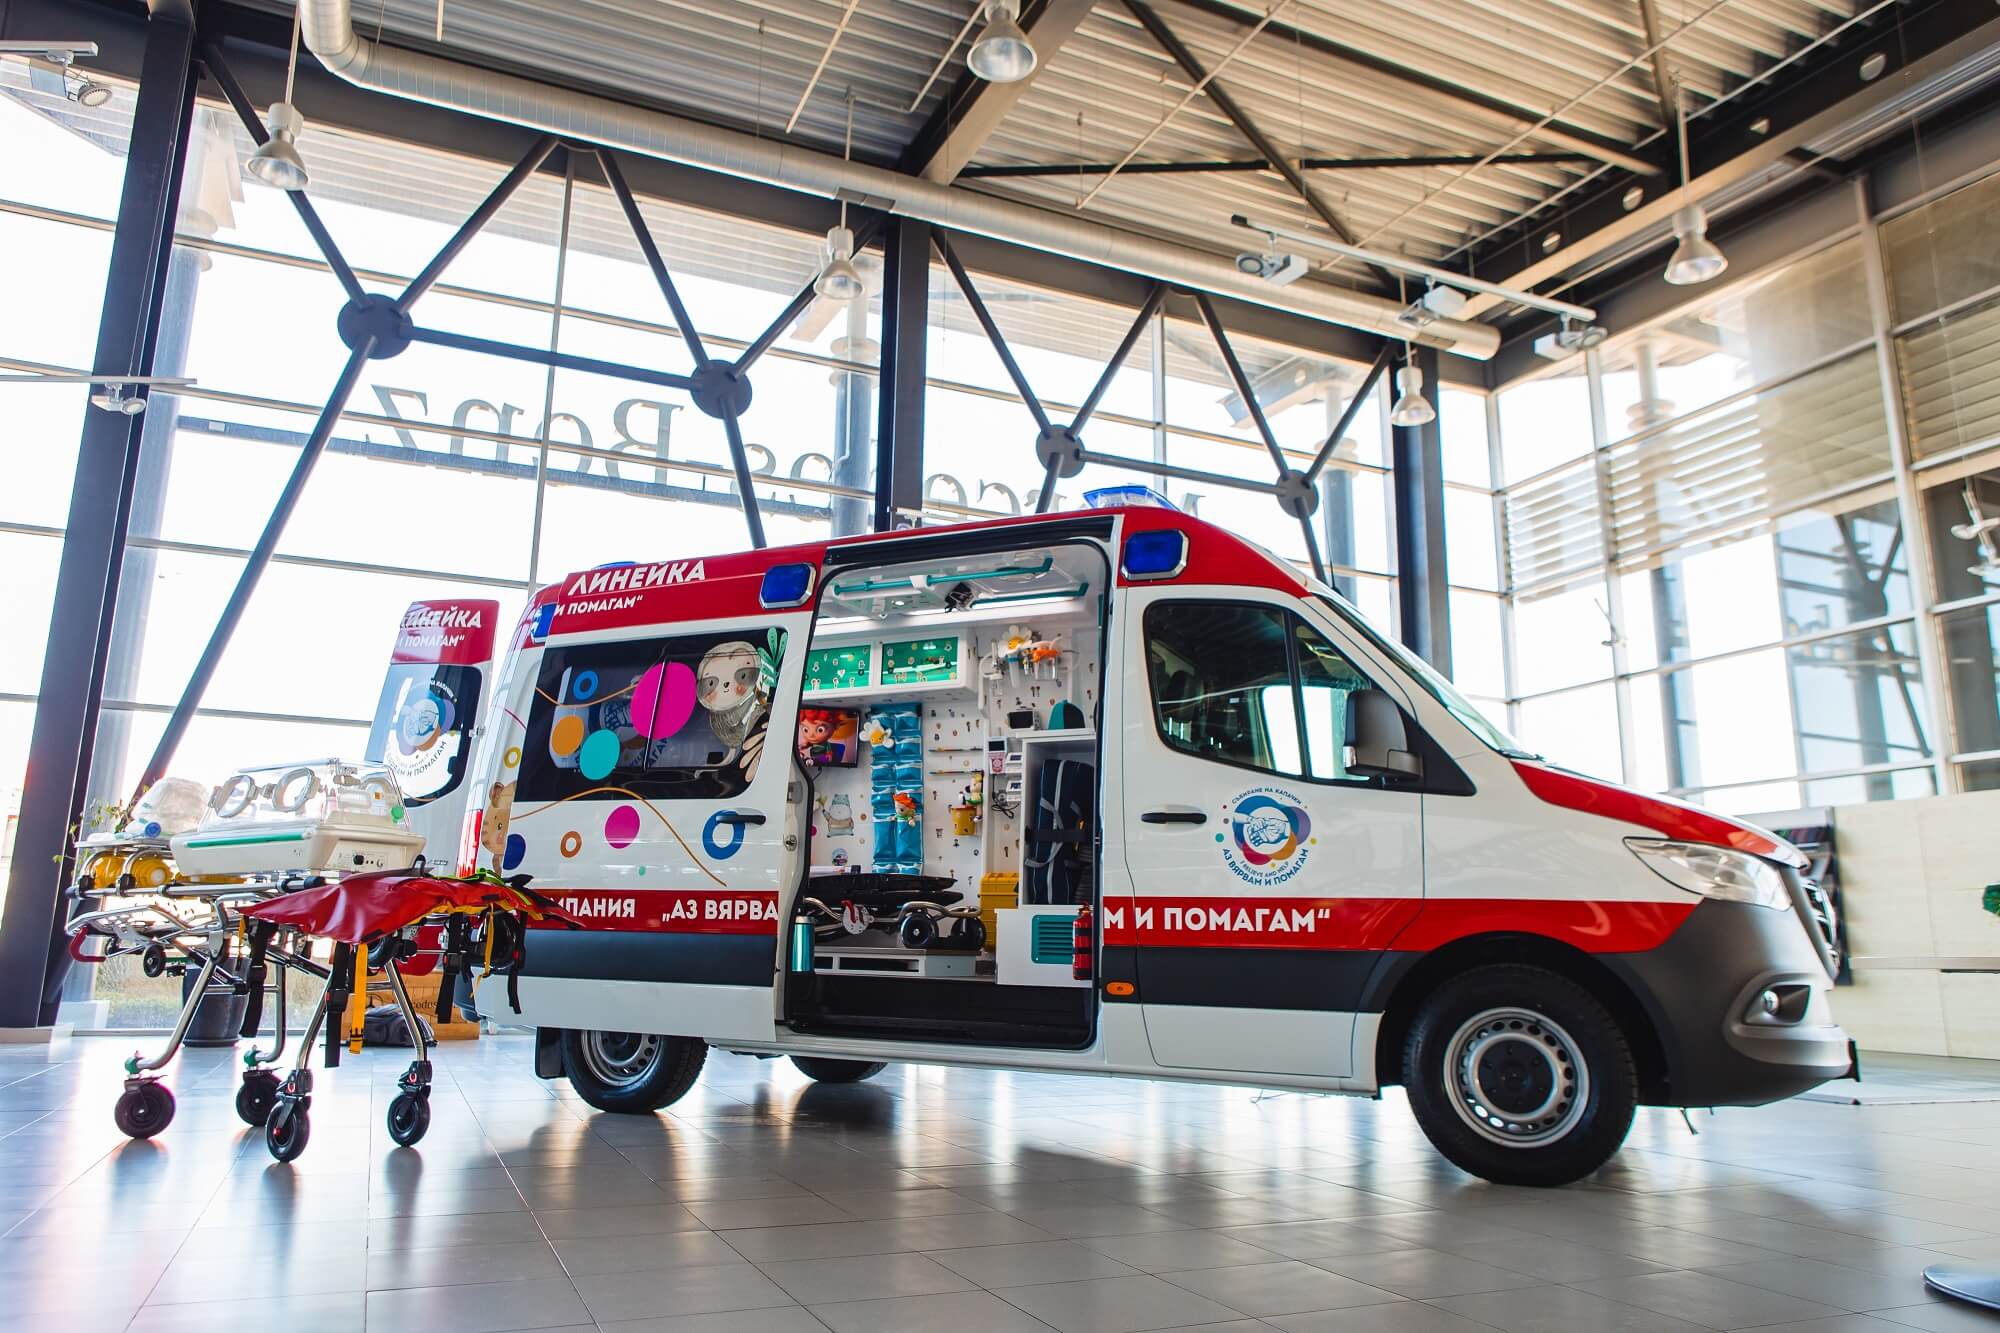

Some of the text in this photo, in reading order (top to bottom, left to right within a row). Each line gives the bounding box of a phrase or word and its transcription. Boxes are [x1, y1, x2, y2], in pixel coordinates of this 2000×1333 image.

[568, 559, 706, 596] ЛИНЕЙКА
[1222, 848, 1232, 860] АЗ
[1229, 861, 1262, 885] ВЯРВАМ
[1273, 848, 1309, 885] ПОМАГАМ
[1135, 907, 1153, 930] И
